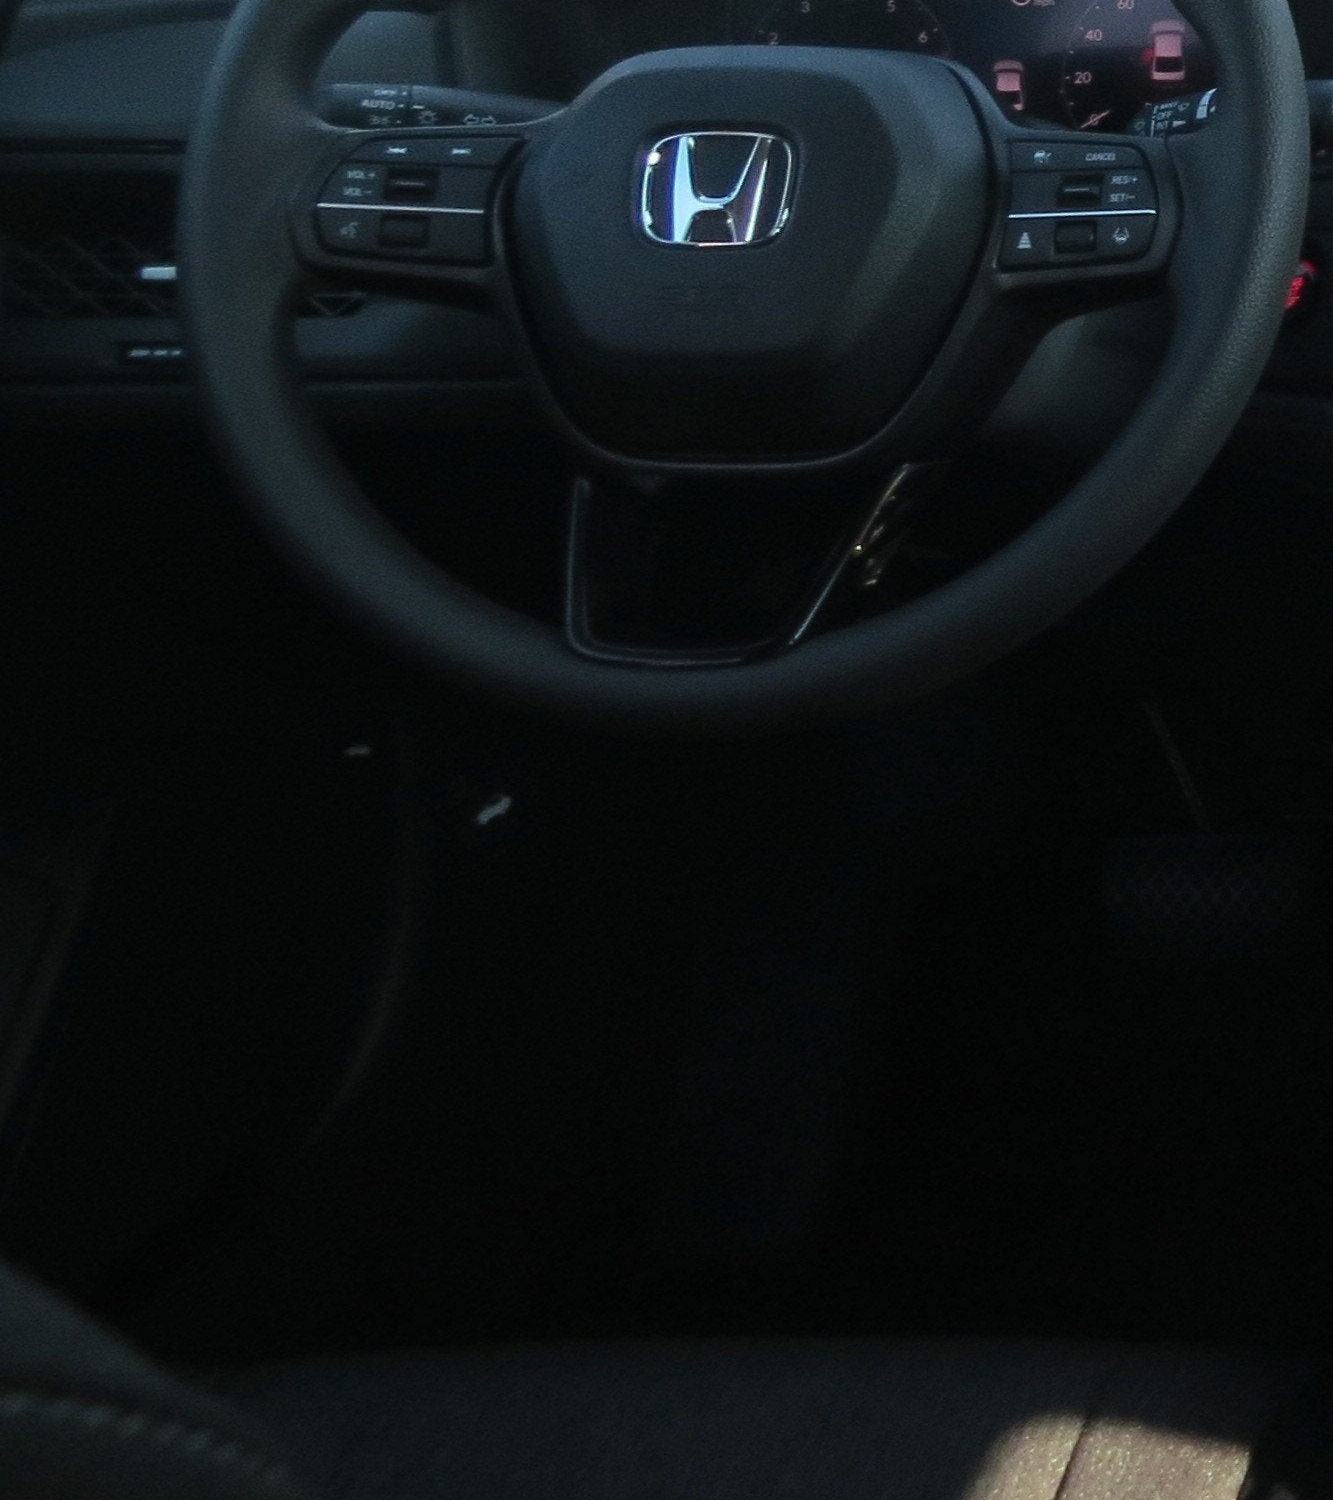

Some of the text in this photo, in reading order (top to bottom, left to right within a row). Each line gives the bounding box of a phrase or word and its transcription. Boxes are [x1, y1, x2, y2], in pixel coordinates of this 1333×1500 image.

[801, 0, 811, 13] 3
[887, 0, 896, 12] 5
[769, 32, 779, 45] 2
[918, 30, 928, 43] 6
[1085, 29, 1103, 41] 40
[1074, 71, 1092, 84] 20
[361, 99, 396, 110] AUTO
[1085, 152, 1116, 162] CANCEL
